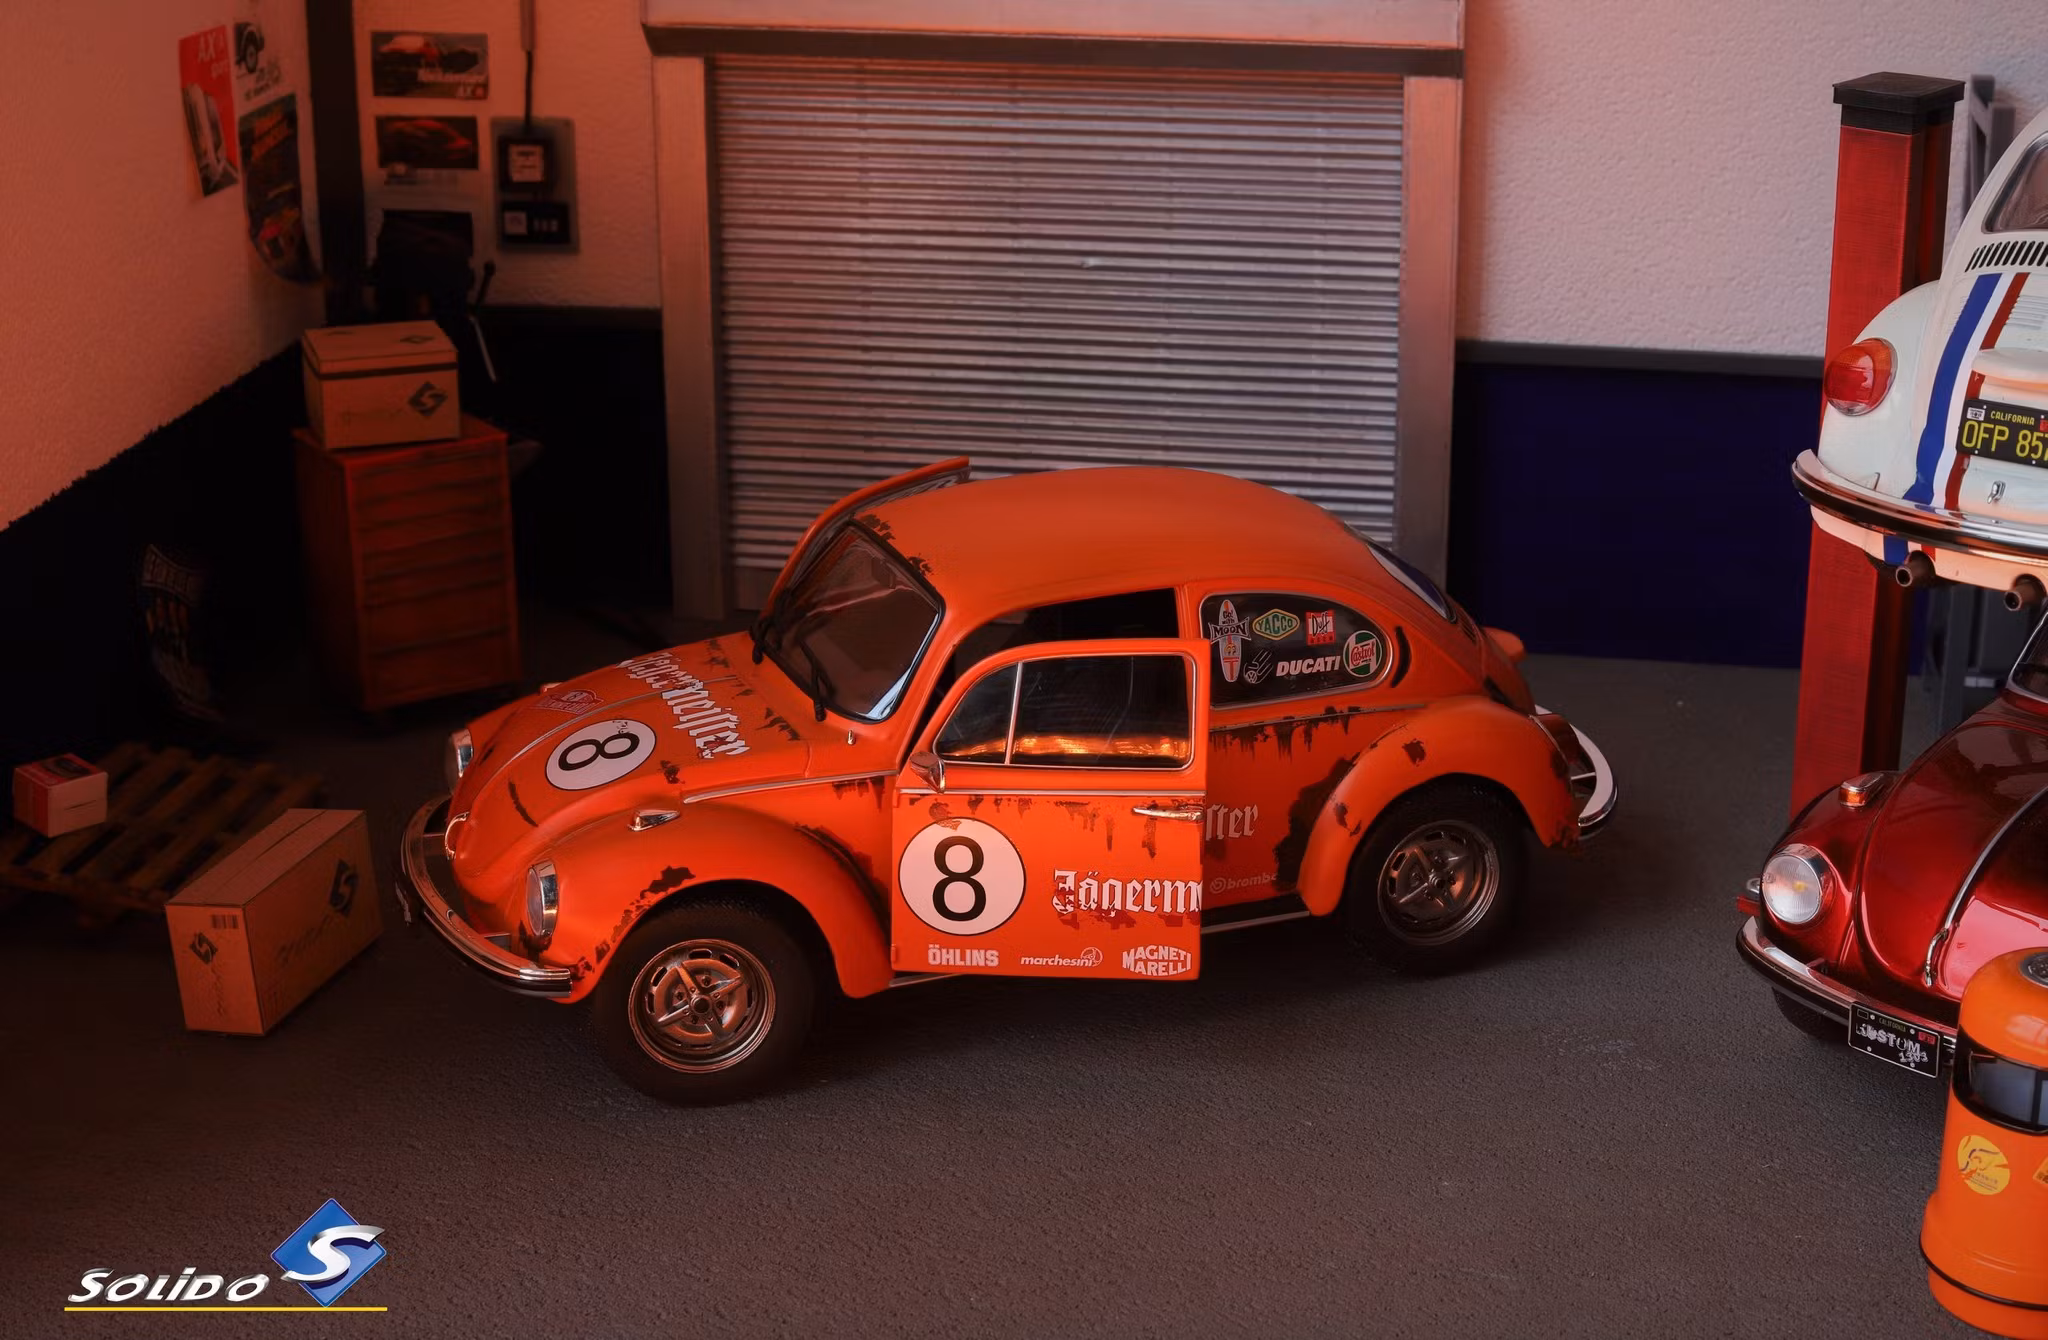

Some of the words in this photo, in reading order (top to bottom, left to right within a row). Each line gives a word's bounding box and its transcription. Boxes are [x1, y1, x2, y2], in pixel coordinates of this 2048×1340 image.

[1990, 410, 2035, 426] CALIFORNIA
[1962, 420, 2009, 452] OFP
[1213, 622, 1247, 638] MOON
[1257, 613, 1293, 634] YACCO
[1351, 641, 1376, 667] Castrol
[1276, 656, 1341, 677] DUCATI
[558, 732, 640, 771] 8
[932, 835, 987, 922] 8
[928, 944, 999, 967] ÖHLINS
[1020, 954, 1093, 967] marchesini
[1122, 945, 1192, 967] MAGNETI
[1122, 955, 1192, 976] MARELLI
[1878, 1017, 1907, 1033] CALIFORNIA
